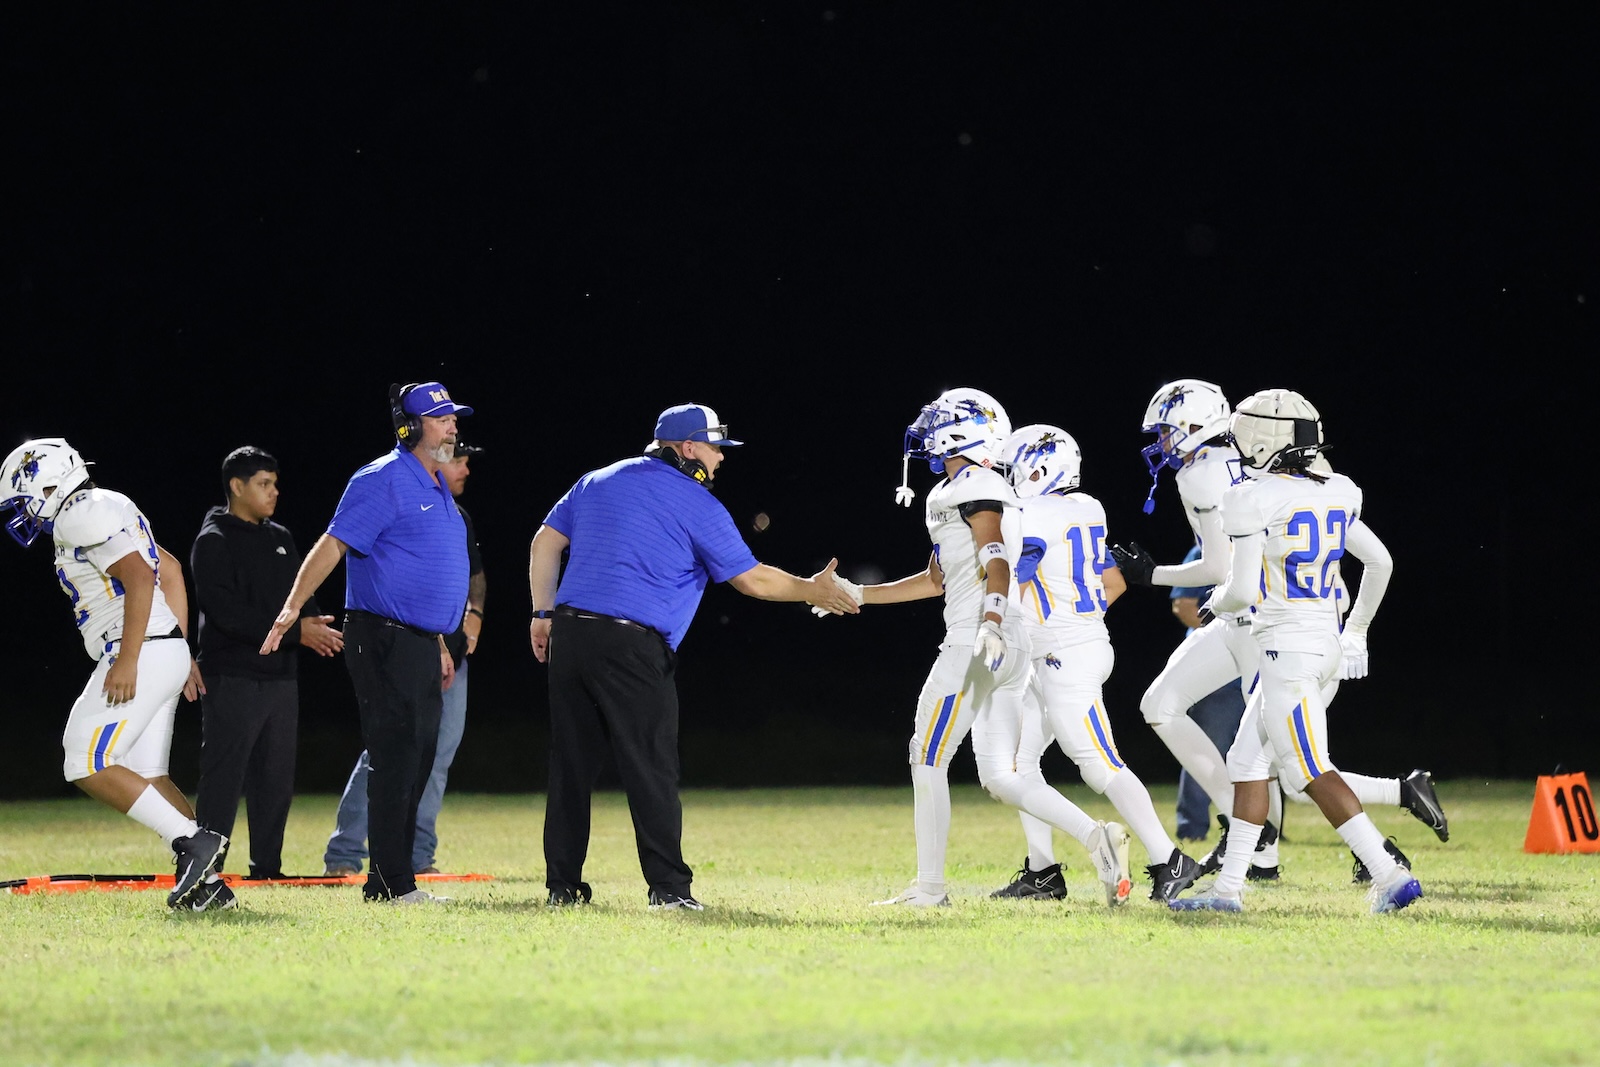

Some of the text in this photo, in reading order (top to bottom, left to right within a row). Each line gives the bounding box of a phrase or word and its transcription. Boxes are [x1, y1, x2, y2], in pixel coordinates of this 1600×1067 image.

[1063, 523, 1108, 616] 15
[1282, 507, 1347, 602] 22
[1554, 784, 1599, 842] 10
